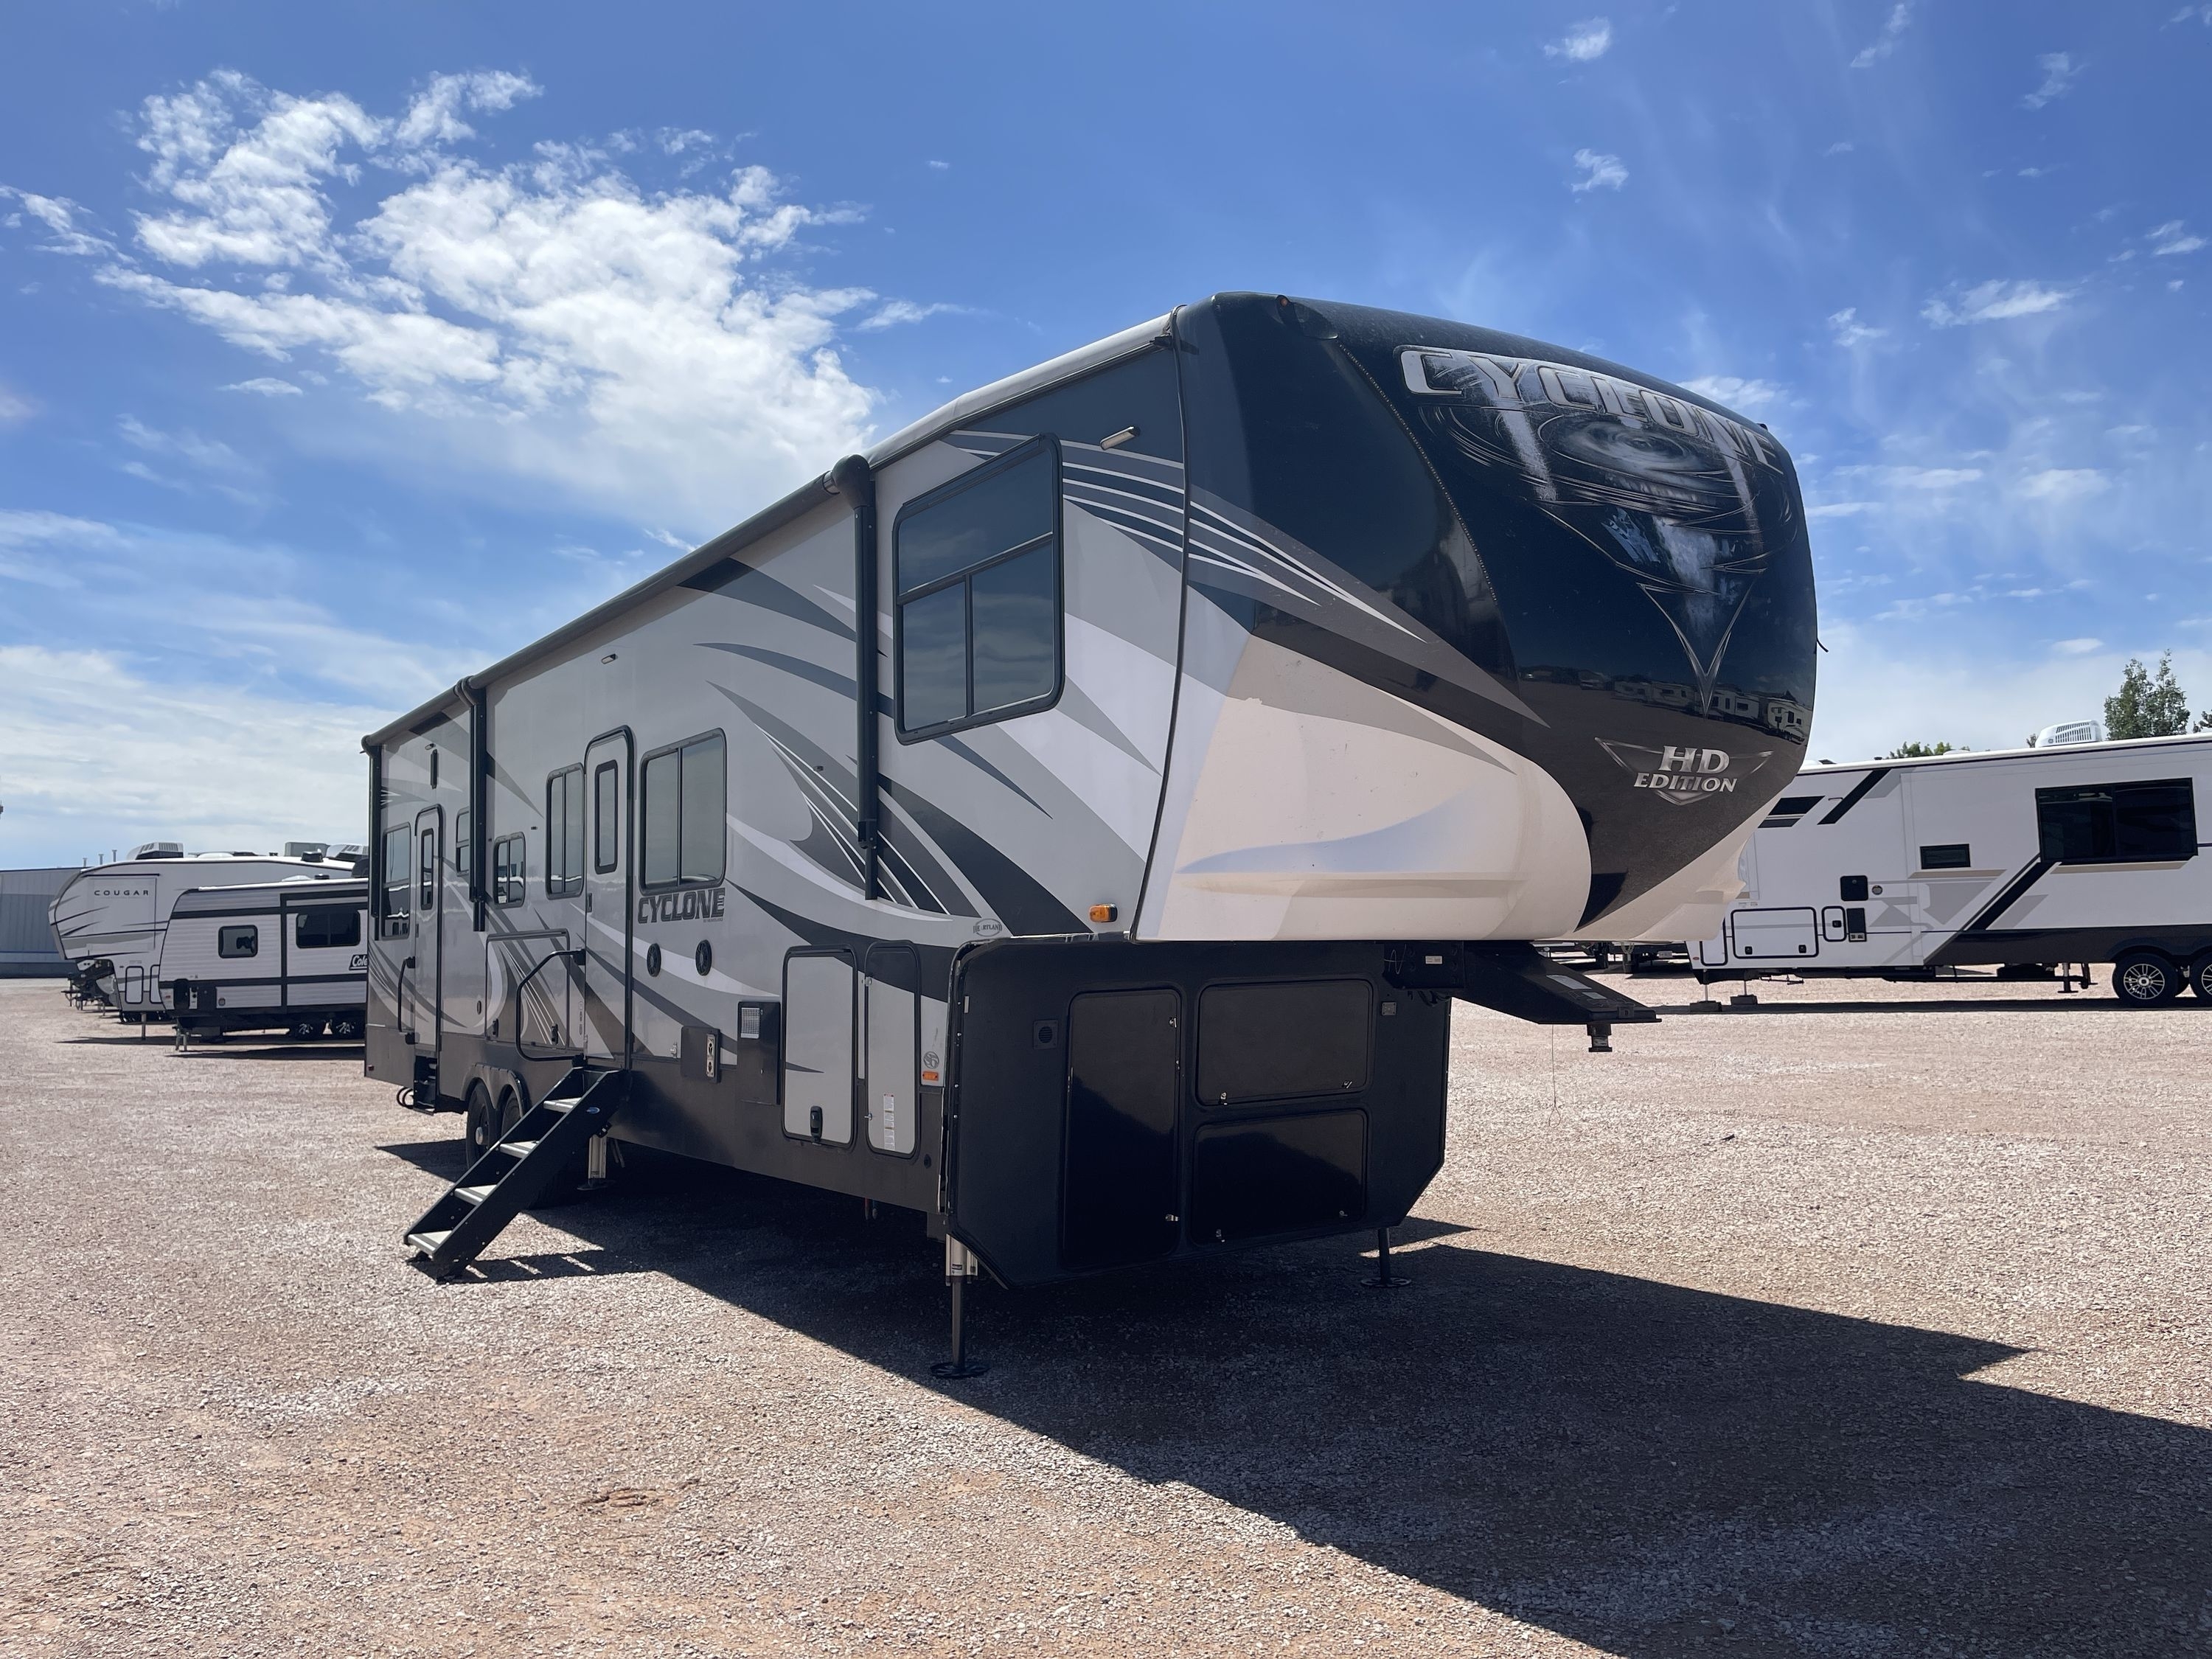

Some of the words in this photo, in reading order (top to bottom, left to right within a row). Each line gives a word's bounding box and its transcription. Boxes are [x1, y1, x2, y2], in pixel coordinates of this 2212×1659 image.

[1399, 347, 1784, 476] CYCLONE
[1658, 745, 1730, 774] HD
[1633, 772, 1738, 793] EDITION
[637, 888, 726, 925] CYCLONE
[973, 923, 1003, 934] HERTLAND
